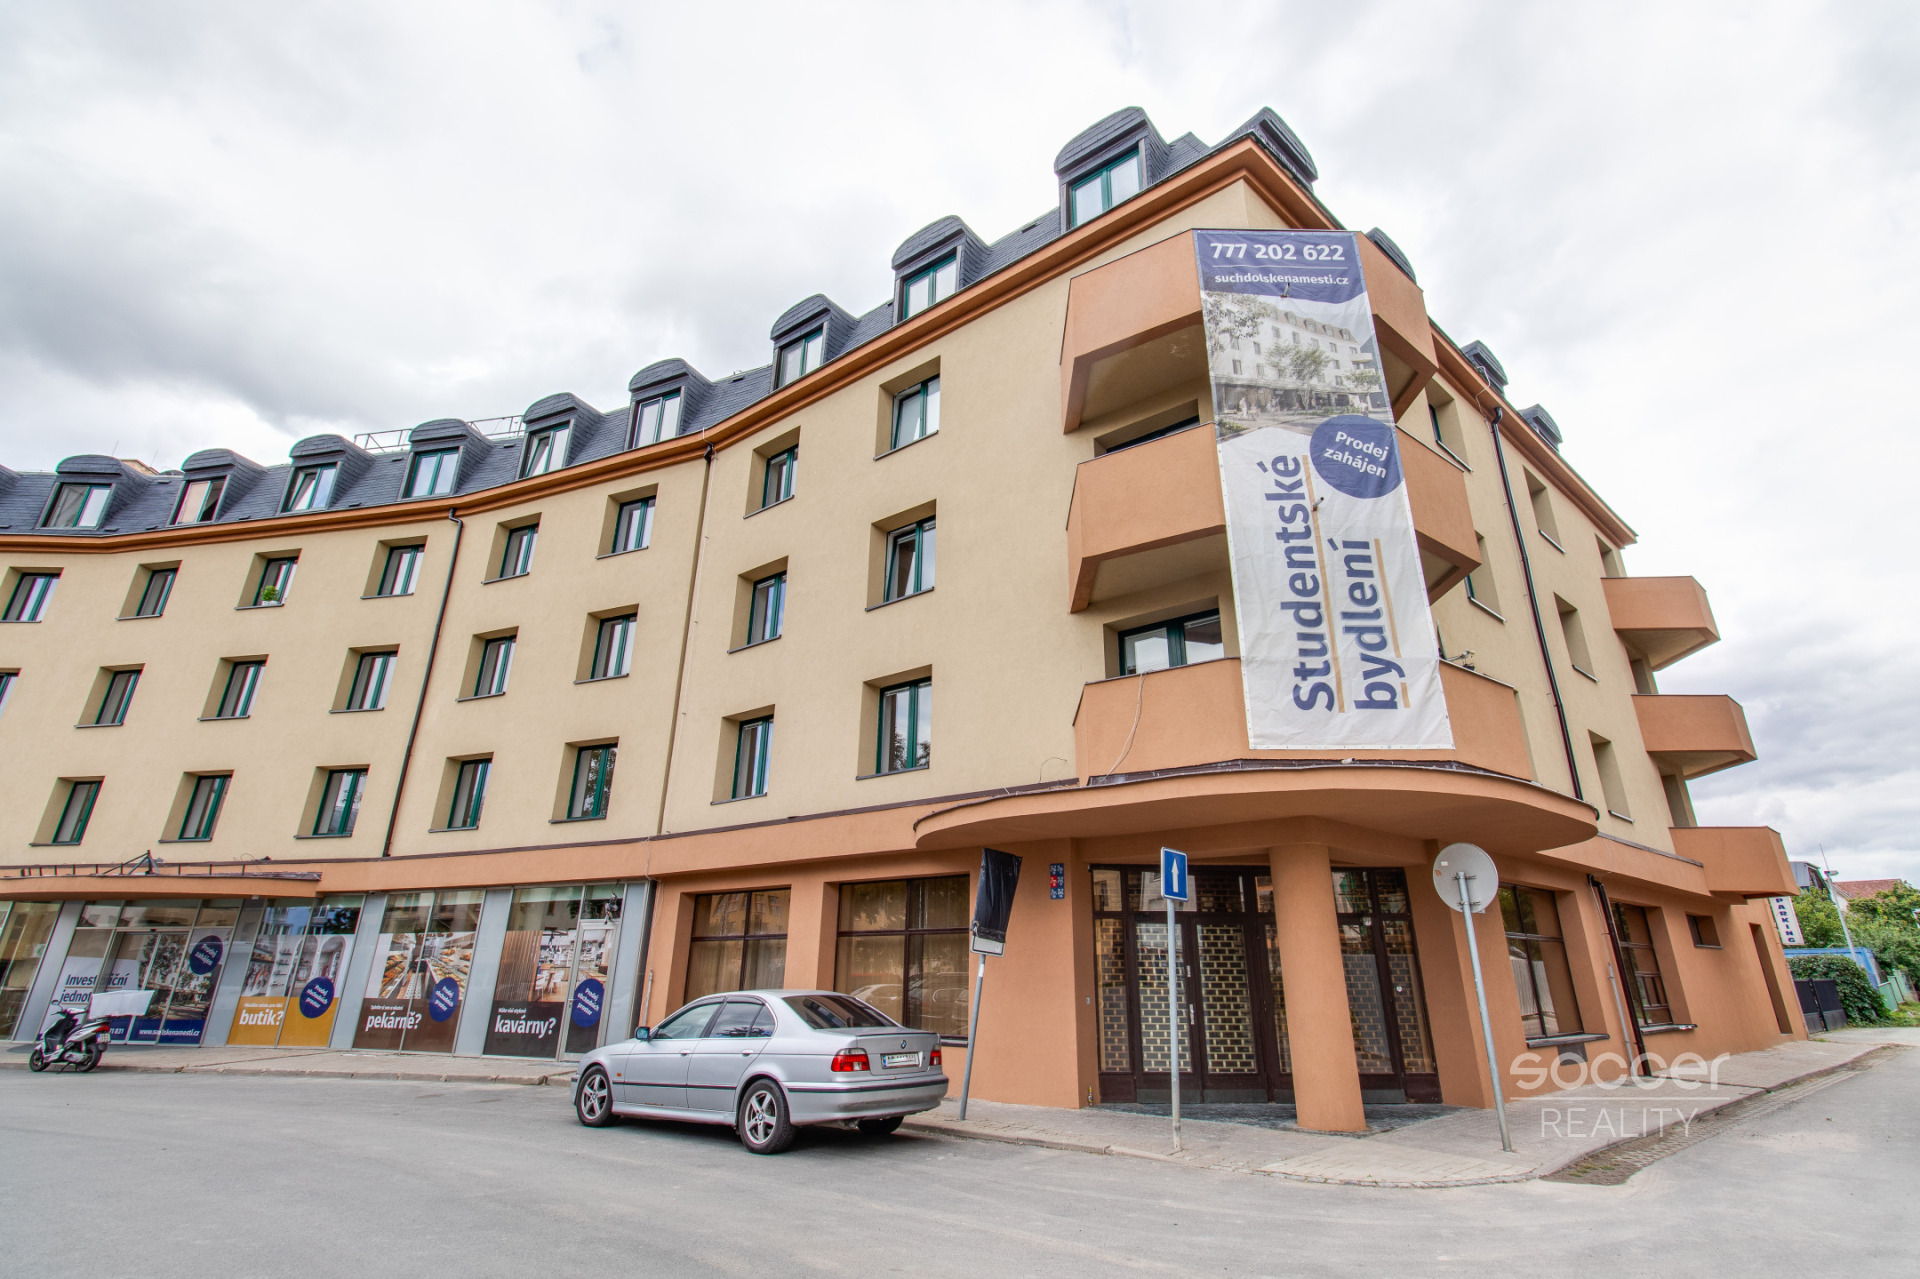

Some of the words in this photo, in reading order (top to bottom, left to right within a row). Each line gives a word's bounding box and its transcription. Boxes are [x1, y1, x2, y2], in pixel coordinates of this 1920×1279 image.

[1210, 243, 1247, 259] 777
[1255, 243, 1297, 260] 202
[1303, 244, 1345, 261] 622
[1214, 272, 1349, 285] suchdolskenamesti.cz
[1334, 431, 1389, 461] Prodej
[1323, 447, 1387, 479] zahájen
[1256, 454, 1334, 712] Studentské
[1327, 537, 1406, 710] bydlení
[1775, 898, 1796, 943] PARKING
[239, 1009, 284, 1026] butik?
[365, 1011, 422, 1032] pekárně?
[494, 1014, 557, 1039] kavárny?
